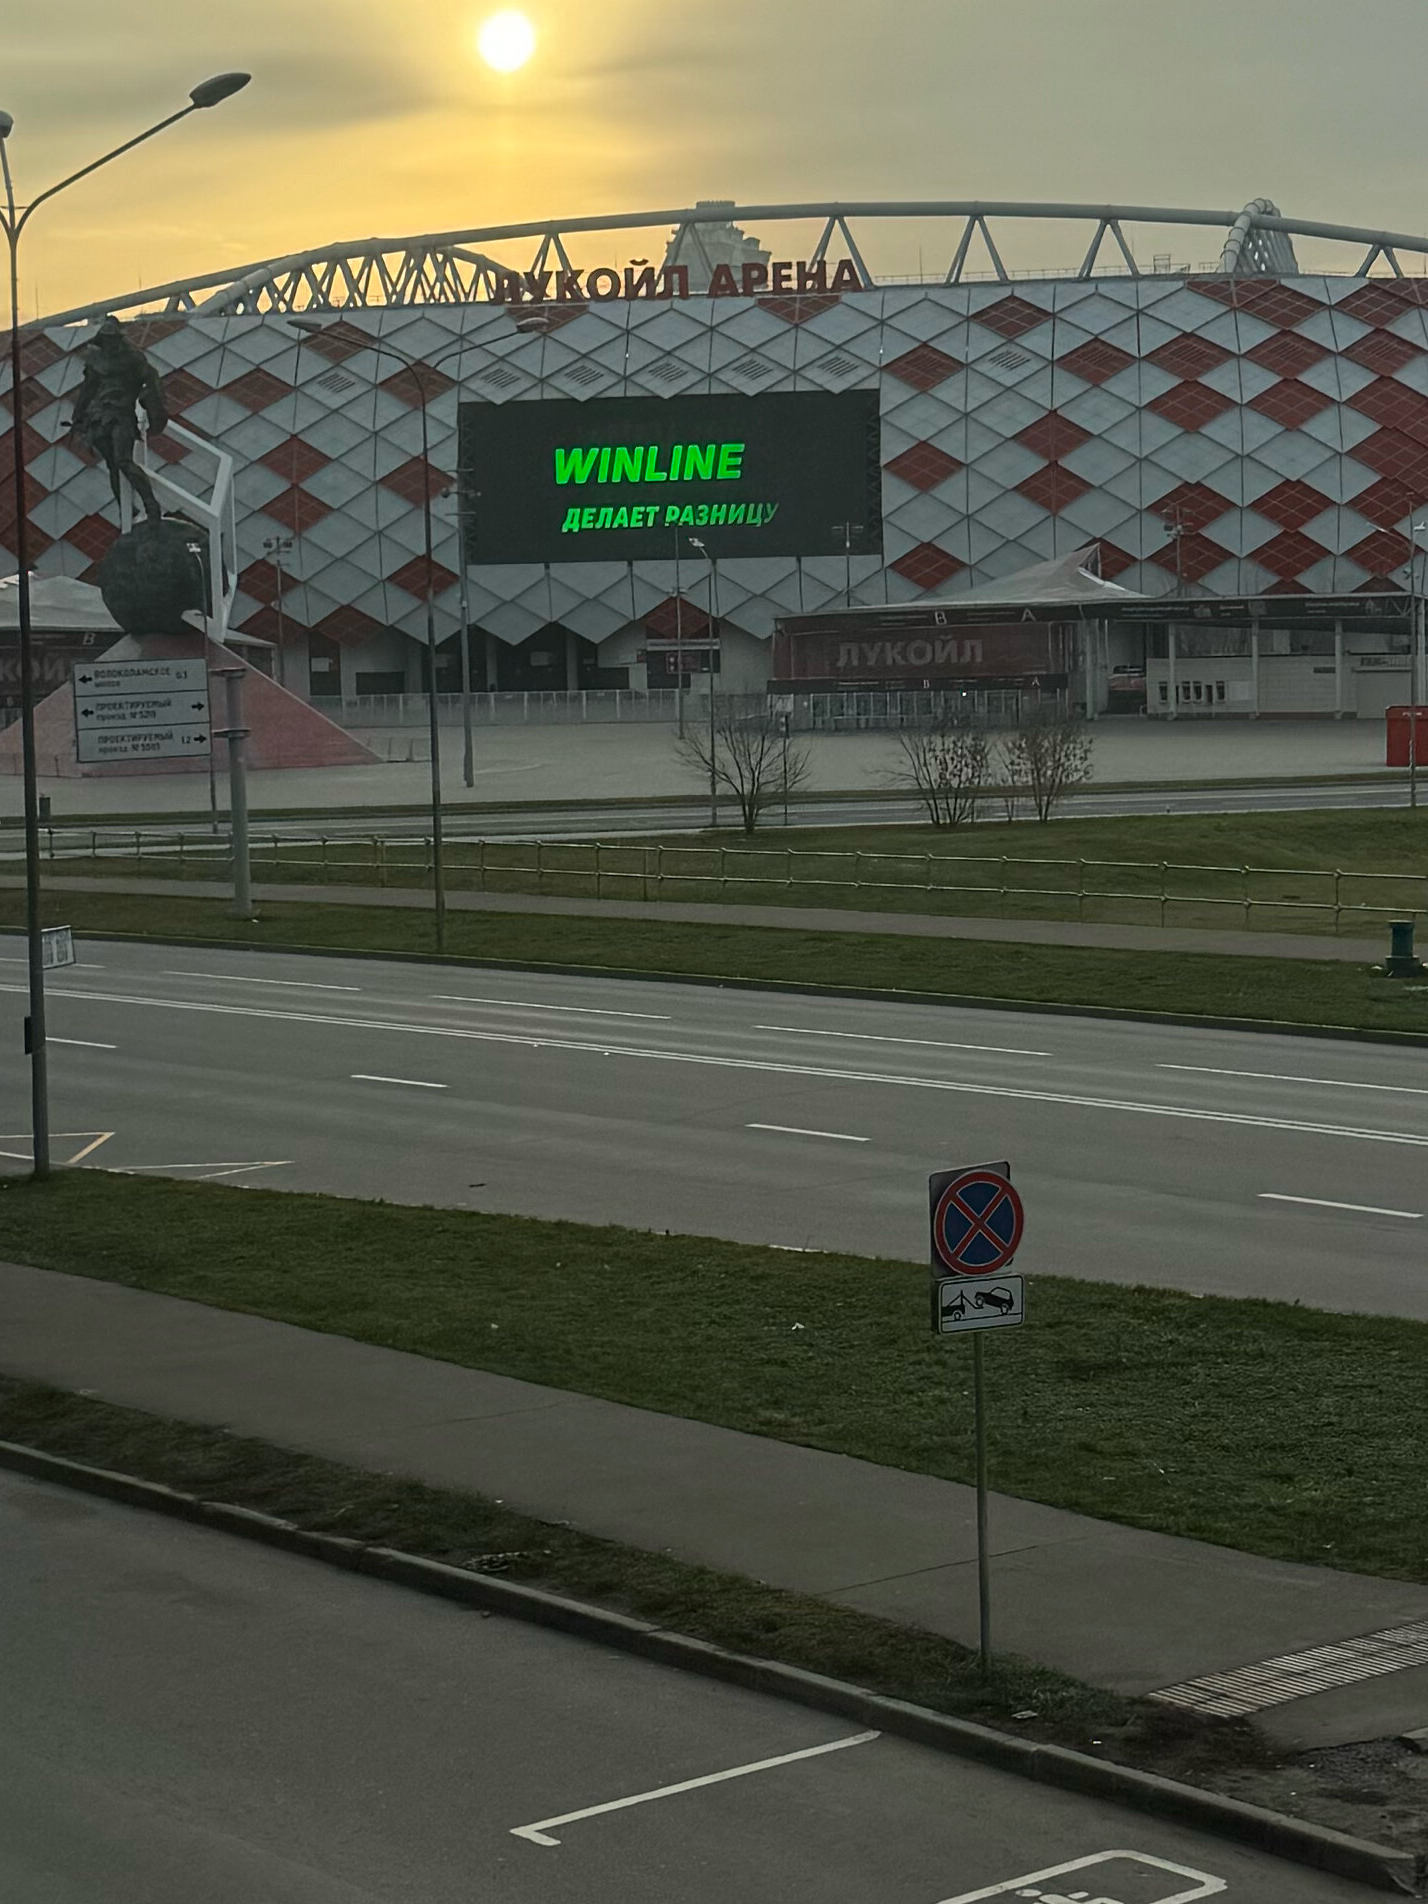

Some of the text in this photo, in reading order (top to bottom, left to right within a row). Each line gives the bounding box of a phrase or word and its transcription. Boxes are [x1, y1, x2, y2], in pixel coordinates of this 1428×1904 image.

[493, 258, 863, 304] ЛУКОЙЛ АРЕНА
[554, 443, 745, 485] WINLINE
[561, 502, 780, 533] ДЕЛАЕТ РАЗНИЦУ
[935, 611, 947, 625] B
[1022, 608, 1037, 622] A
[836, 634, 984, 667] ЛУКОЙЛ
